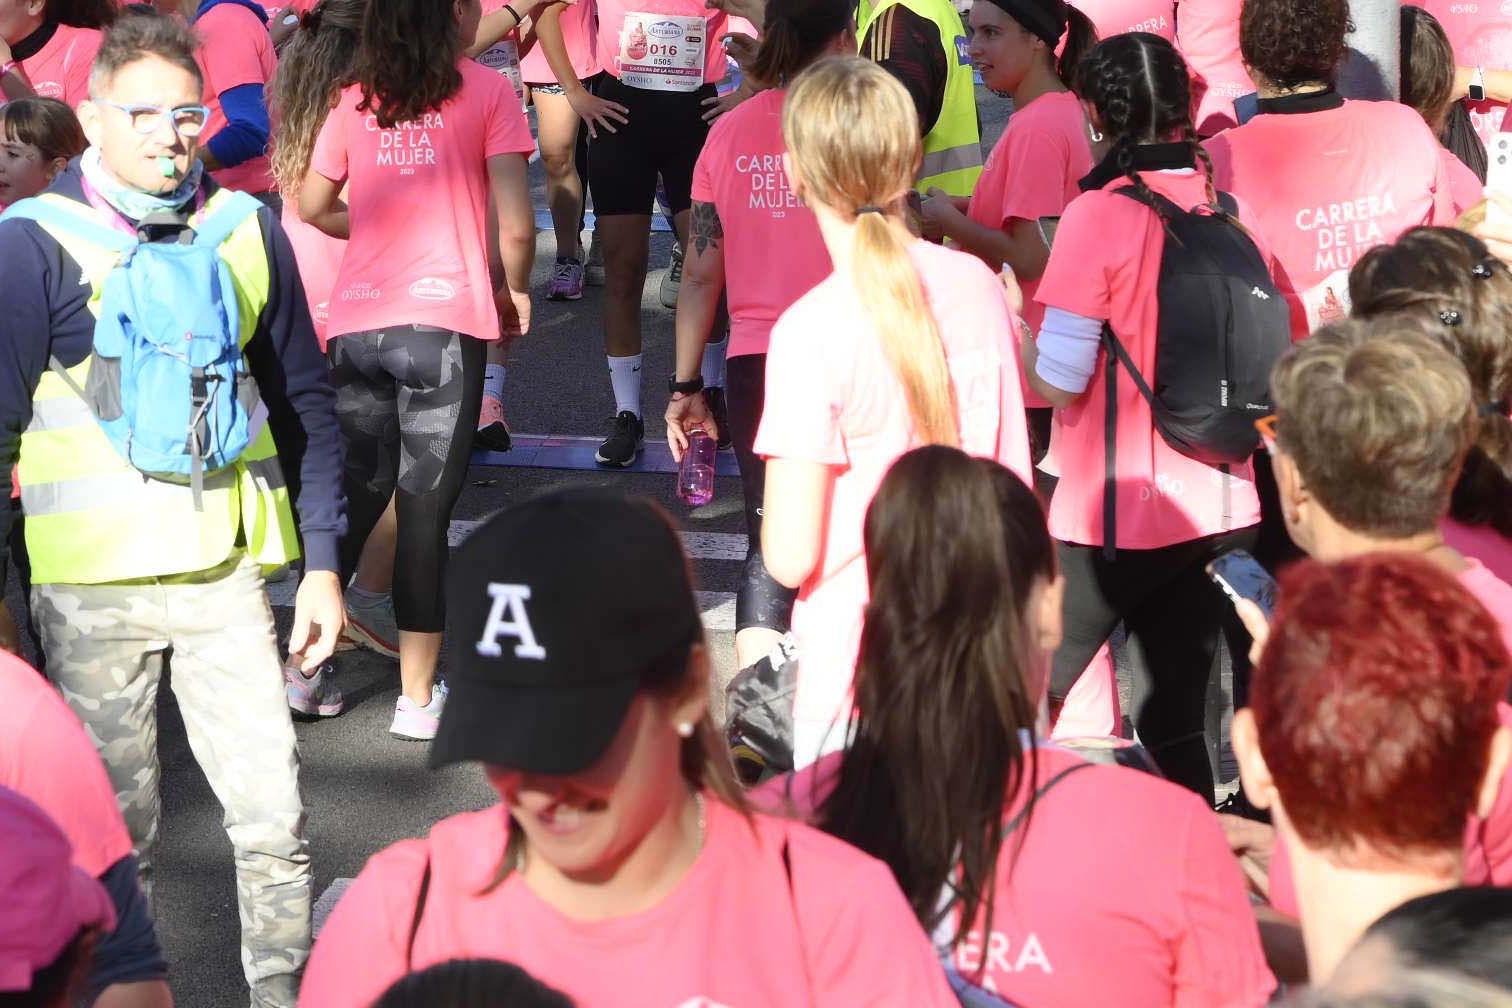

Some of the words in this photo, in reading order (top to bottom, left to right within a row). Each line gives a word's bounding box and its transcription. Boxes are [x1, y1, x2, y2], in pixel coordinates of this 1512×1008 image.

[650, 44, 678, 56] 016
[380, 132, 403, 149] DE
[409, 131, 432, 148] LA
[376, 148, 436, 166] MUJER
[751, 173, 776, 191] DE
[1295, 192, 1398, 231] CARRERA
[1318, 228, 1347, 250] DE
[1354, 221, 1383, 243] LA
[476, 582, 546, 661] A
[958, 934, 1052, 974] ERA
